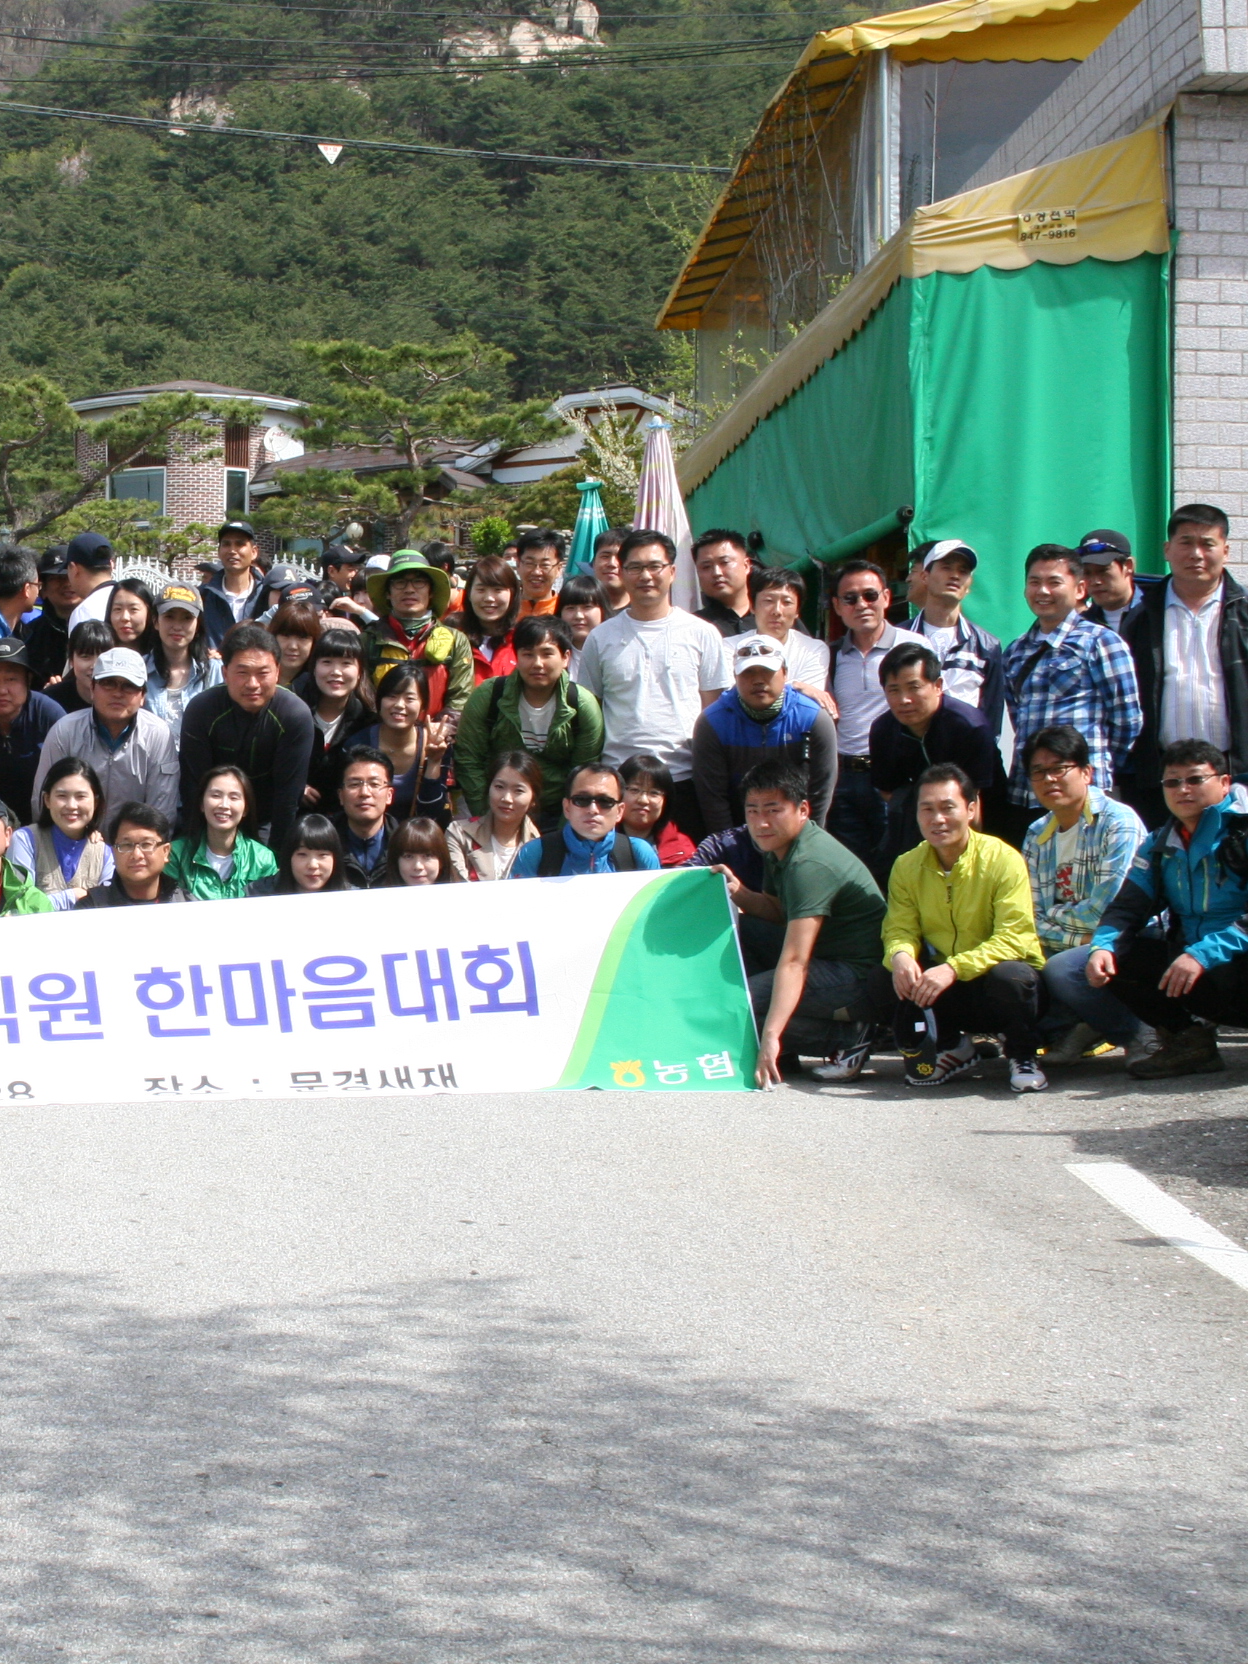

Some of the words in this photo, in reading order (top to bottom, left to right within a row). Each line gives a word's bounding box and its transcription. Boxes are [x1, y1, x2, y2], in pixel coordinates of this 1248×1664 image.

[1020, 229, 1076, 241] 847-9816
[133, 941, 541, 1038] 한마음대회
[653, 1050, 735, 1085] 농협
